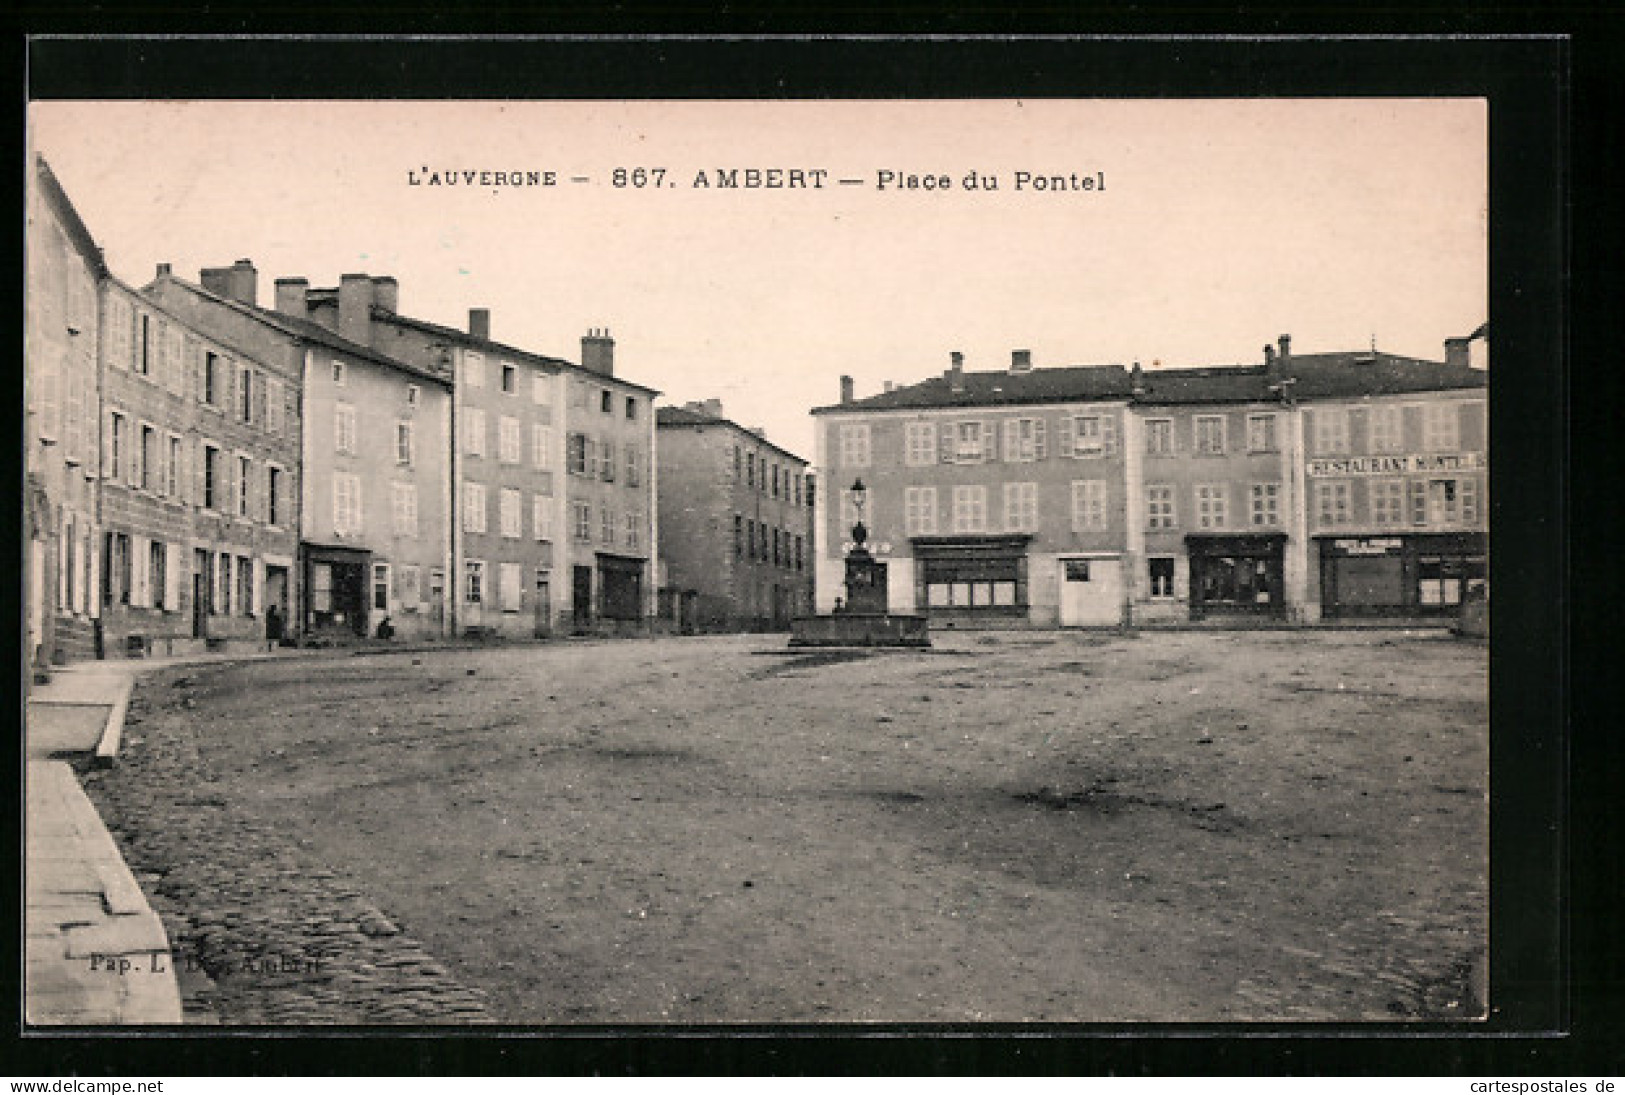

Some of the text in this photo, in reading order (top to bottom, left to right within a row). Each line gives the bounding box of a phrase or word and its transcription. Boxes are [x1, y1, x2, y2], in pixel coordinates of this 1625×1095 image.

[408, 166, 557, 187] L'AUVERGNE
[612, 166, 676, 189] 867.
[692, 168, 828, 189] AMBERT
[876, 169, 951, 191] Place
[961, 170, 998, 191] du
[1014, 171, 1106, 191] Pontel
